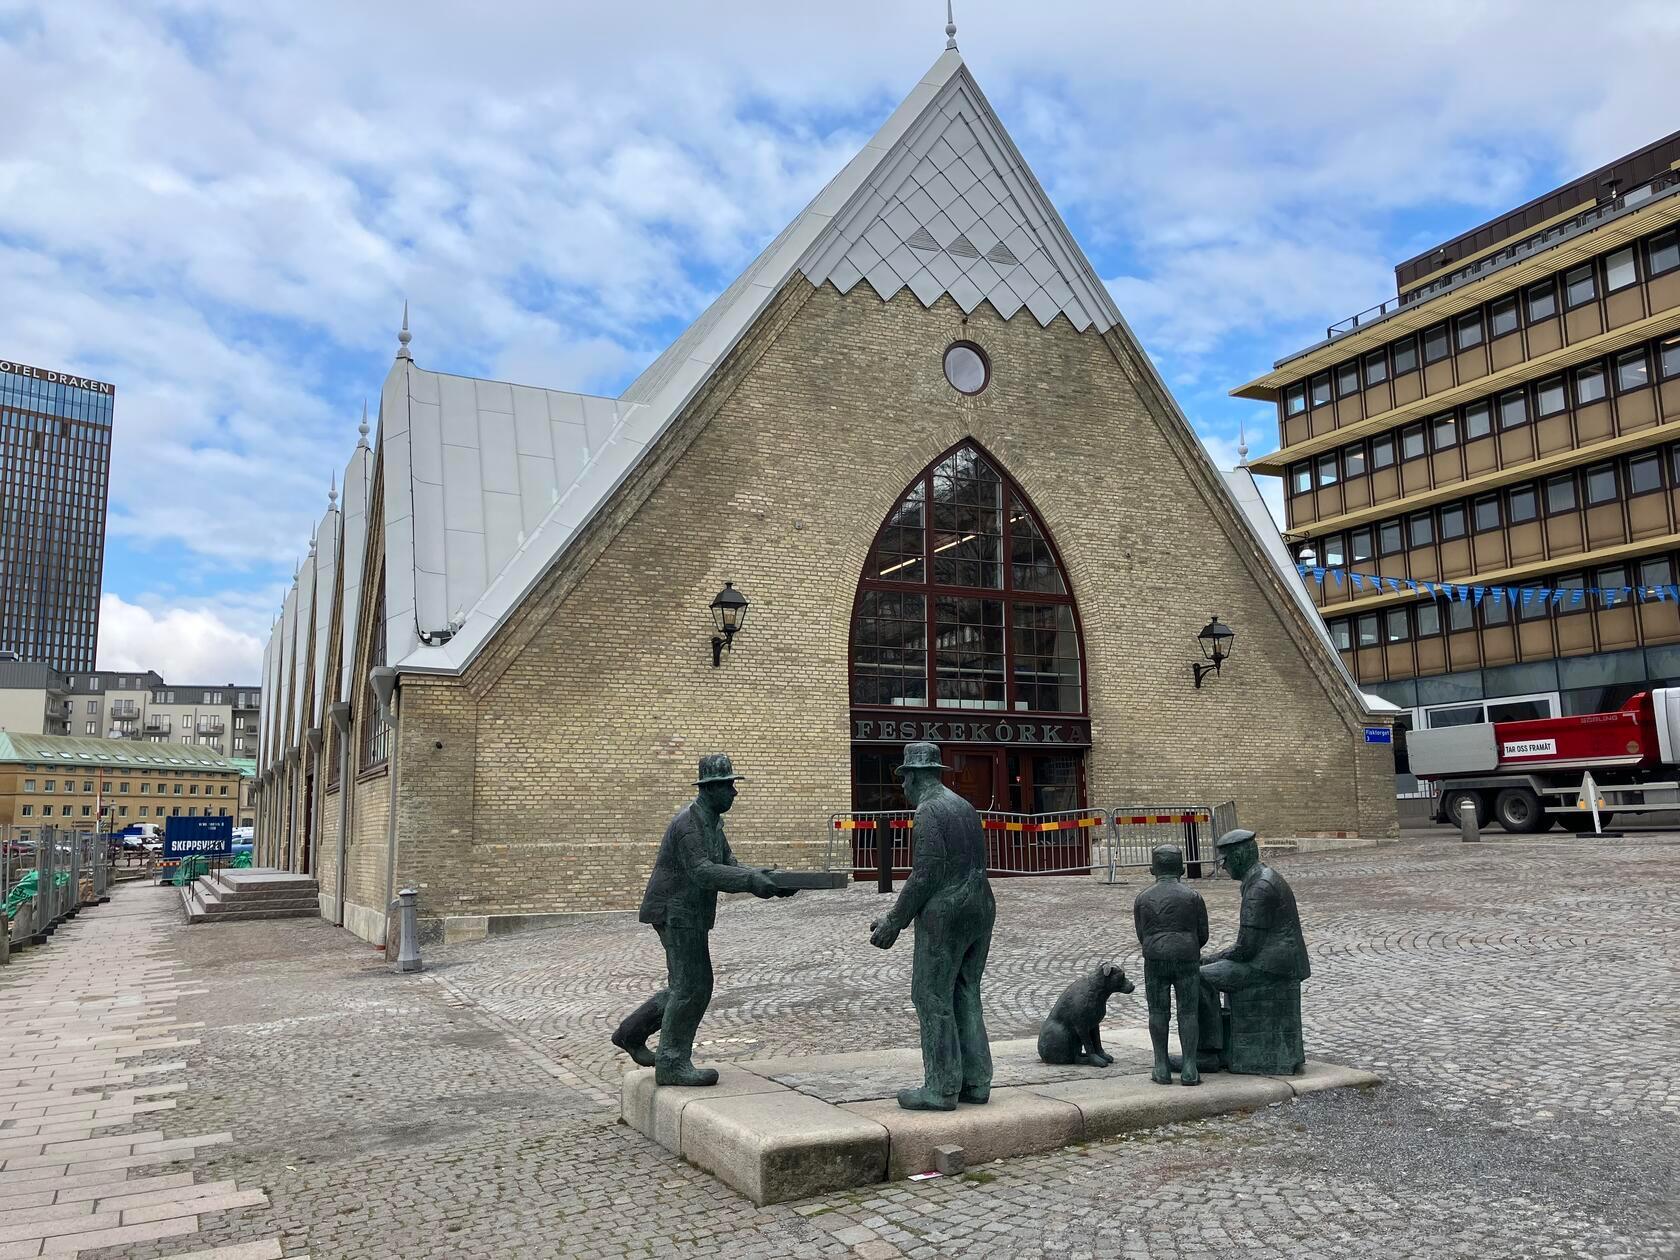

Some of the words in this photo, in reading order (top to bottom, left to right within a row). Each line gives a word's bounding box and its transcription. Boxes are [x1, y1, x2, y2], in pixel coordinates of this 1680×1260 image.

[47, 371, 109, 393] DRAKEN
[855, 719, 1086, 743] FESKEKÔRKA
[1529, 742, 1551, 752] FRAMÅT
